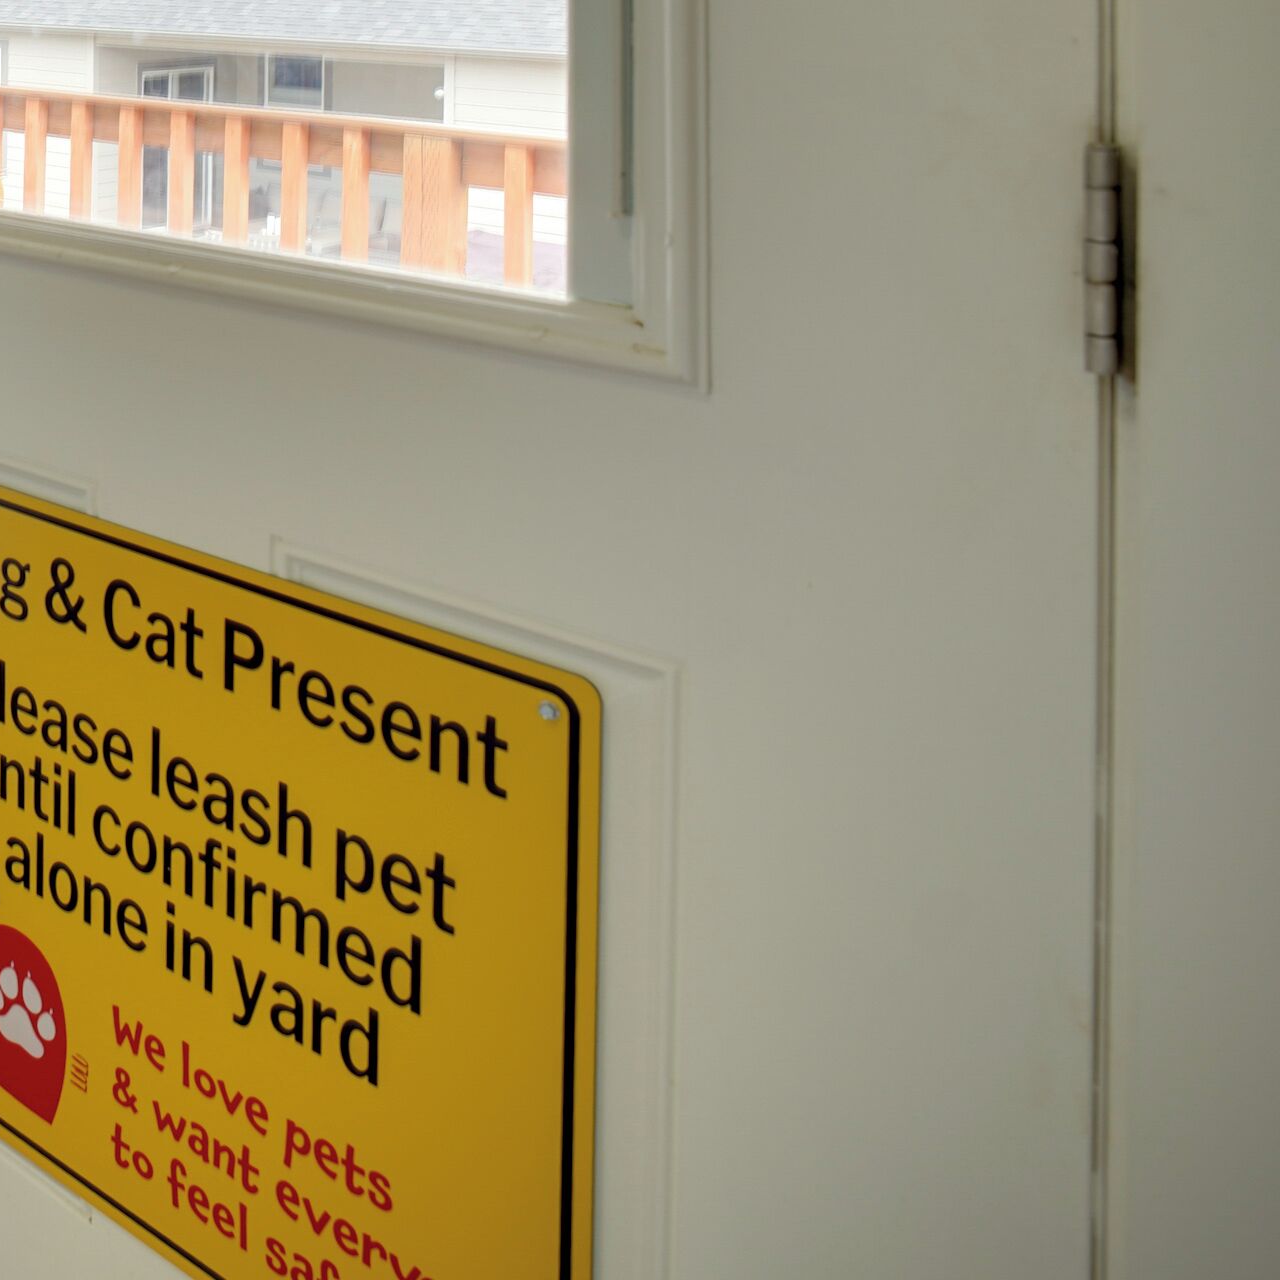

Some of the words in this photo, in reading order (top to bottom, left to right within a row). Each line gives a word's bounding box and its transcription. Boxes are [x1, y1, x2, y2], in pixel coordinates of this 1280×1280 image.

[44, 558, 87, 633] &
[103, 579, 204, 679] Cat
[224, 618, 508, 800] Present
[92, 805, 422, 1016] confirmed
[151, 727, 312, 869] leash
[335, 829, 456, 935] pet
[5, 832, 148, 952] alone
[166, 901, 213, 993] in
[233, 956, 379, 1087] yard
[111, 1123, 154, 1180] to
[167, 1158, 248, 1252] feel
[112, 1005, 166, 1072] We
[182, 1041, 269, 1136] love
[283, 1119, 393, 1212] pets
[112, 1067, 138, 1114] &
[152, 1100, 260, 1195] want
[275, 1180, 433, 1280] every
